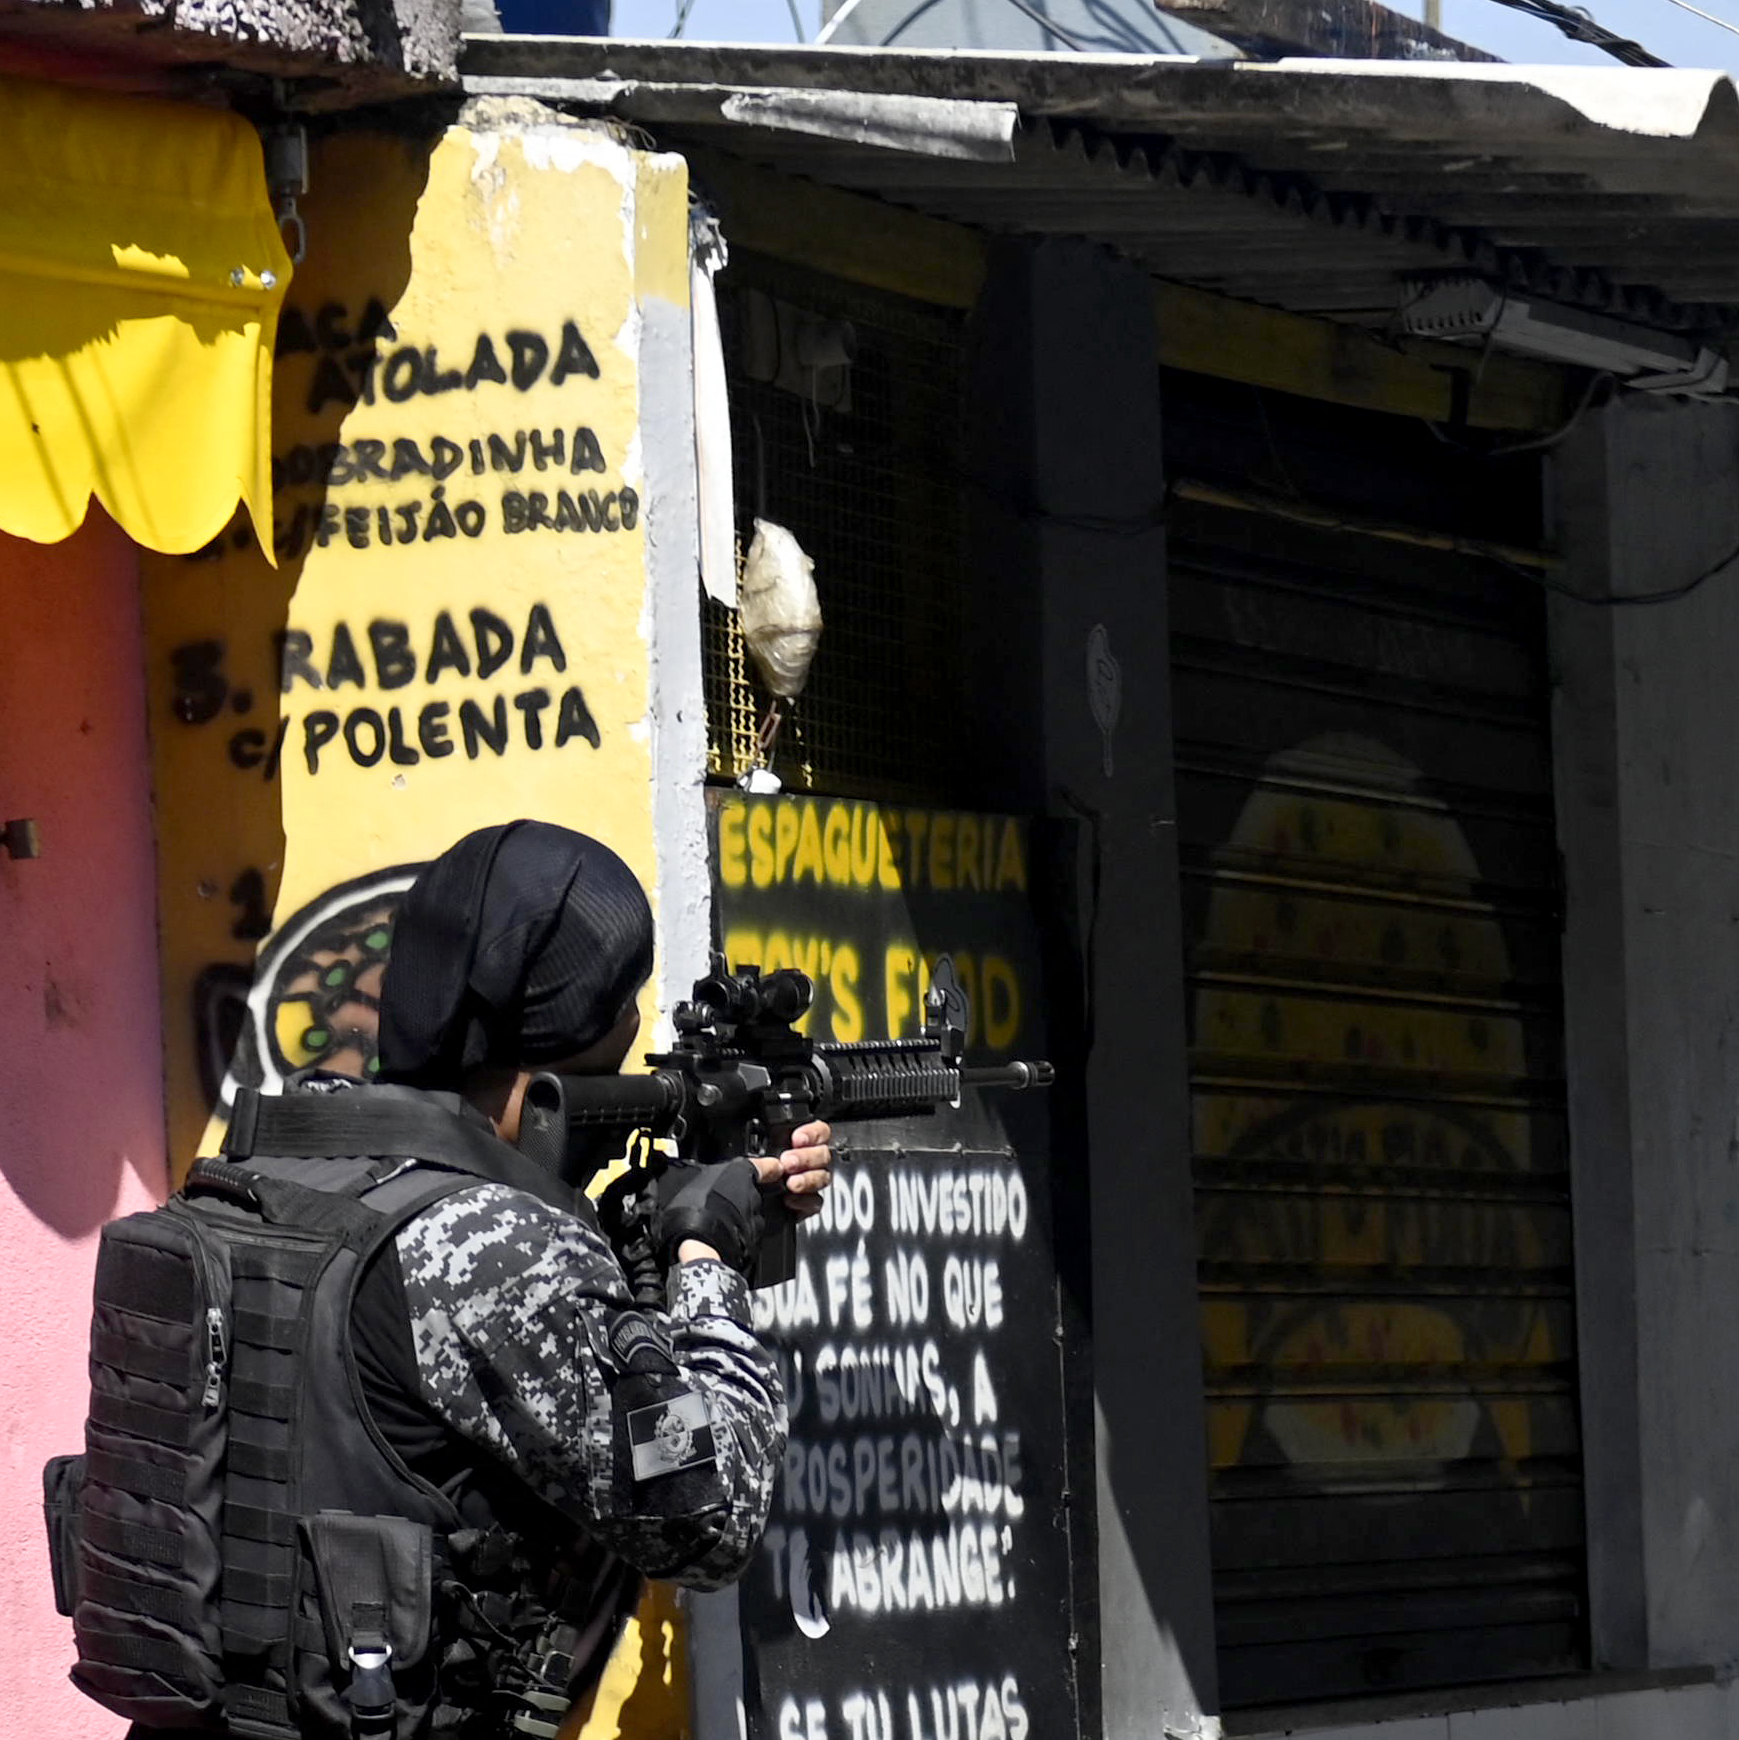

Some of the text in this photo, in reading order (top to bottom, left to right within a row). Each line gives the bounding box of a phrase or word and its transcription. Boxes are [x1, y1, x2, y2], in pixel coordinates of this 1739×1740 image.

[306, 319, 601, 413] ATOLADA
[502, 486, 639, 534] BRANCO
[273, 602, 567, 694] RABADA
[303, 685, 601, 776] POLENTA
[718, 800, 1029, 893] ESPAGUETERIA
[884, 942, 1022, 1052] FOD
[805, 1165, 1029, 1242] NDO INVESTIDO
[825, 1236, 873, 1331] FÉ
[884, 1244, 929, 1331] NO
[943, 1254, 1004, 1330] QUE
[973, 1345, 999, 1427] A
[782, 1430, 1026, 1521] ROSPERIDADE
